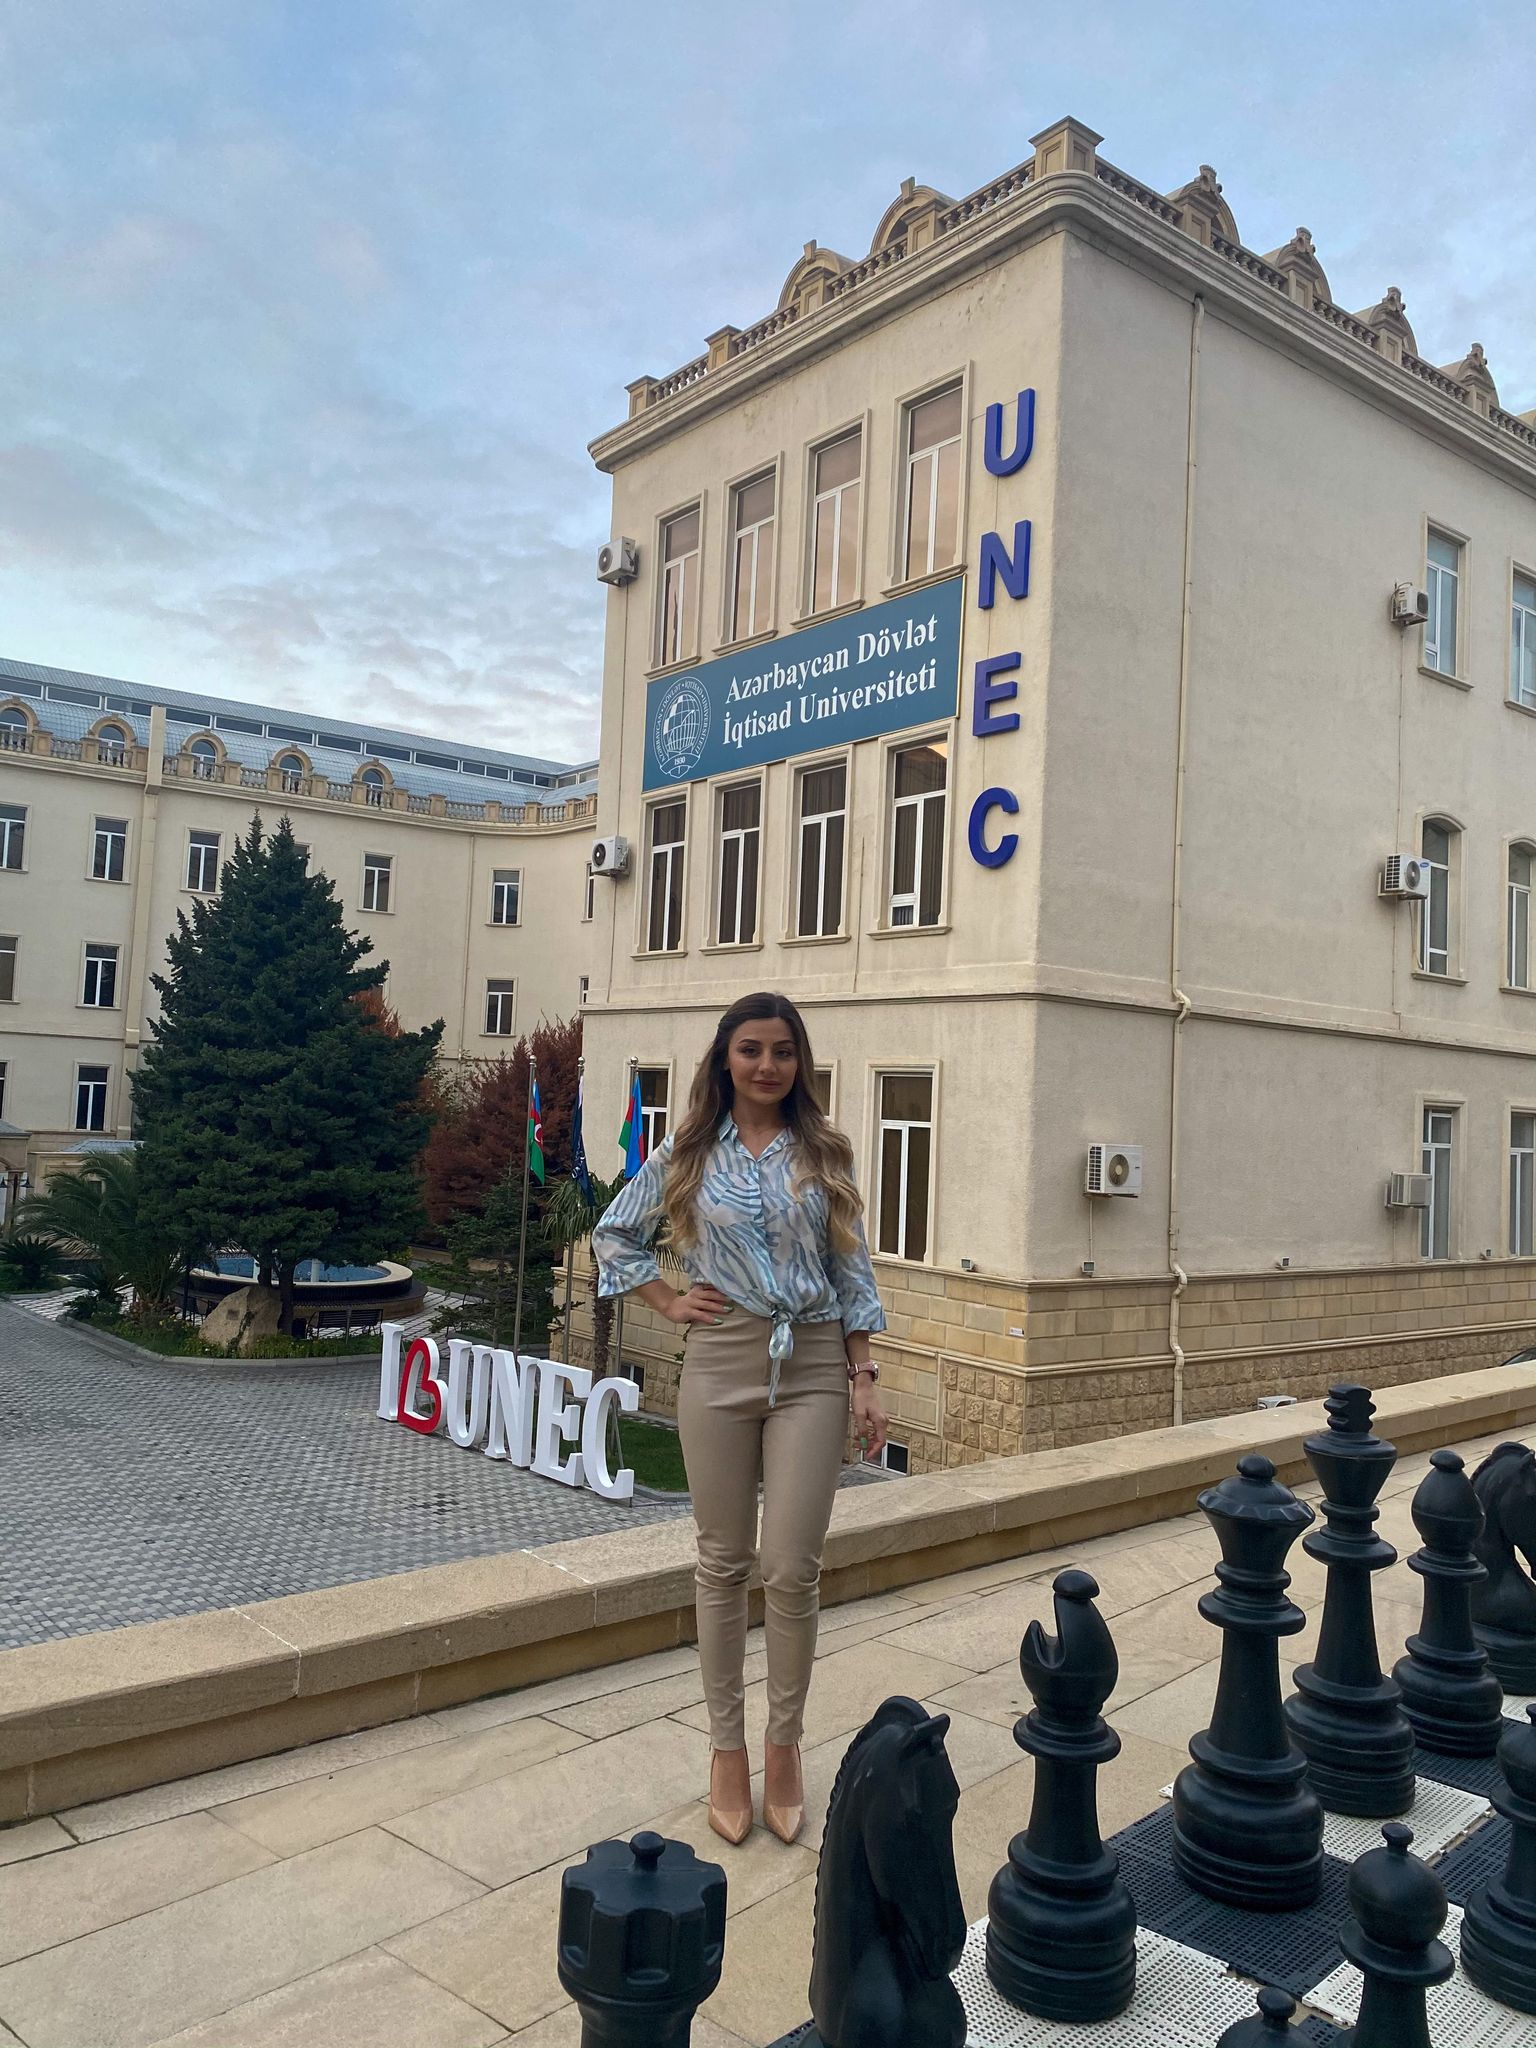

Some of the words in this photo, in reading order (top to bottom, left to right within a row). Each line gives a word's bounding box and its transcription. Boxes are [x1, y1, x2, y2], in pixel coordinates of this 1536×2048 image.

[724, 646, 849, 705] Azərbaycan
[856, 613, 938, 664] Dövlət
[968, 388, 1035, 869] UNEC
[722, 700, 791, 749] İqtisad
[798, 658, 936, 724] Universiteti
[377, 1323, 404, 1421] I
[446, 1338, 639, 1499] UNEC
